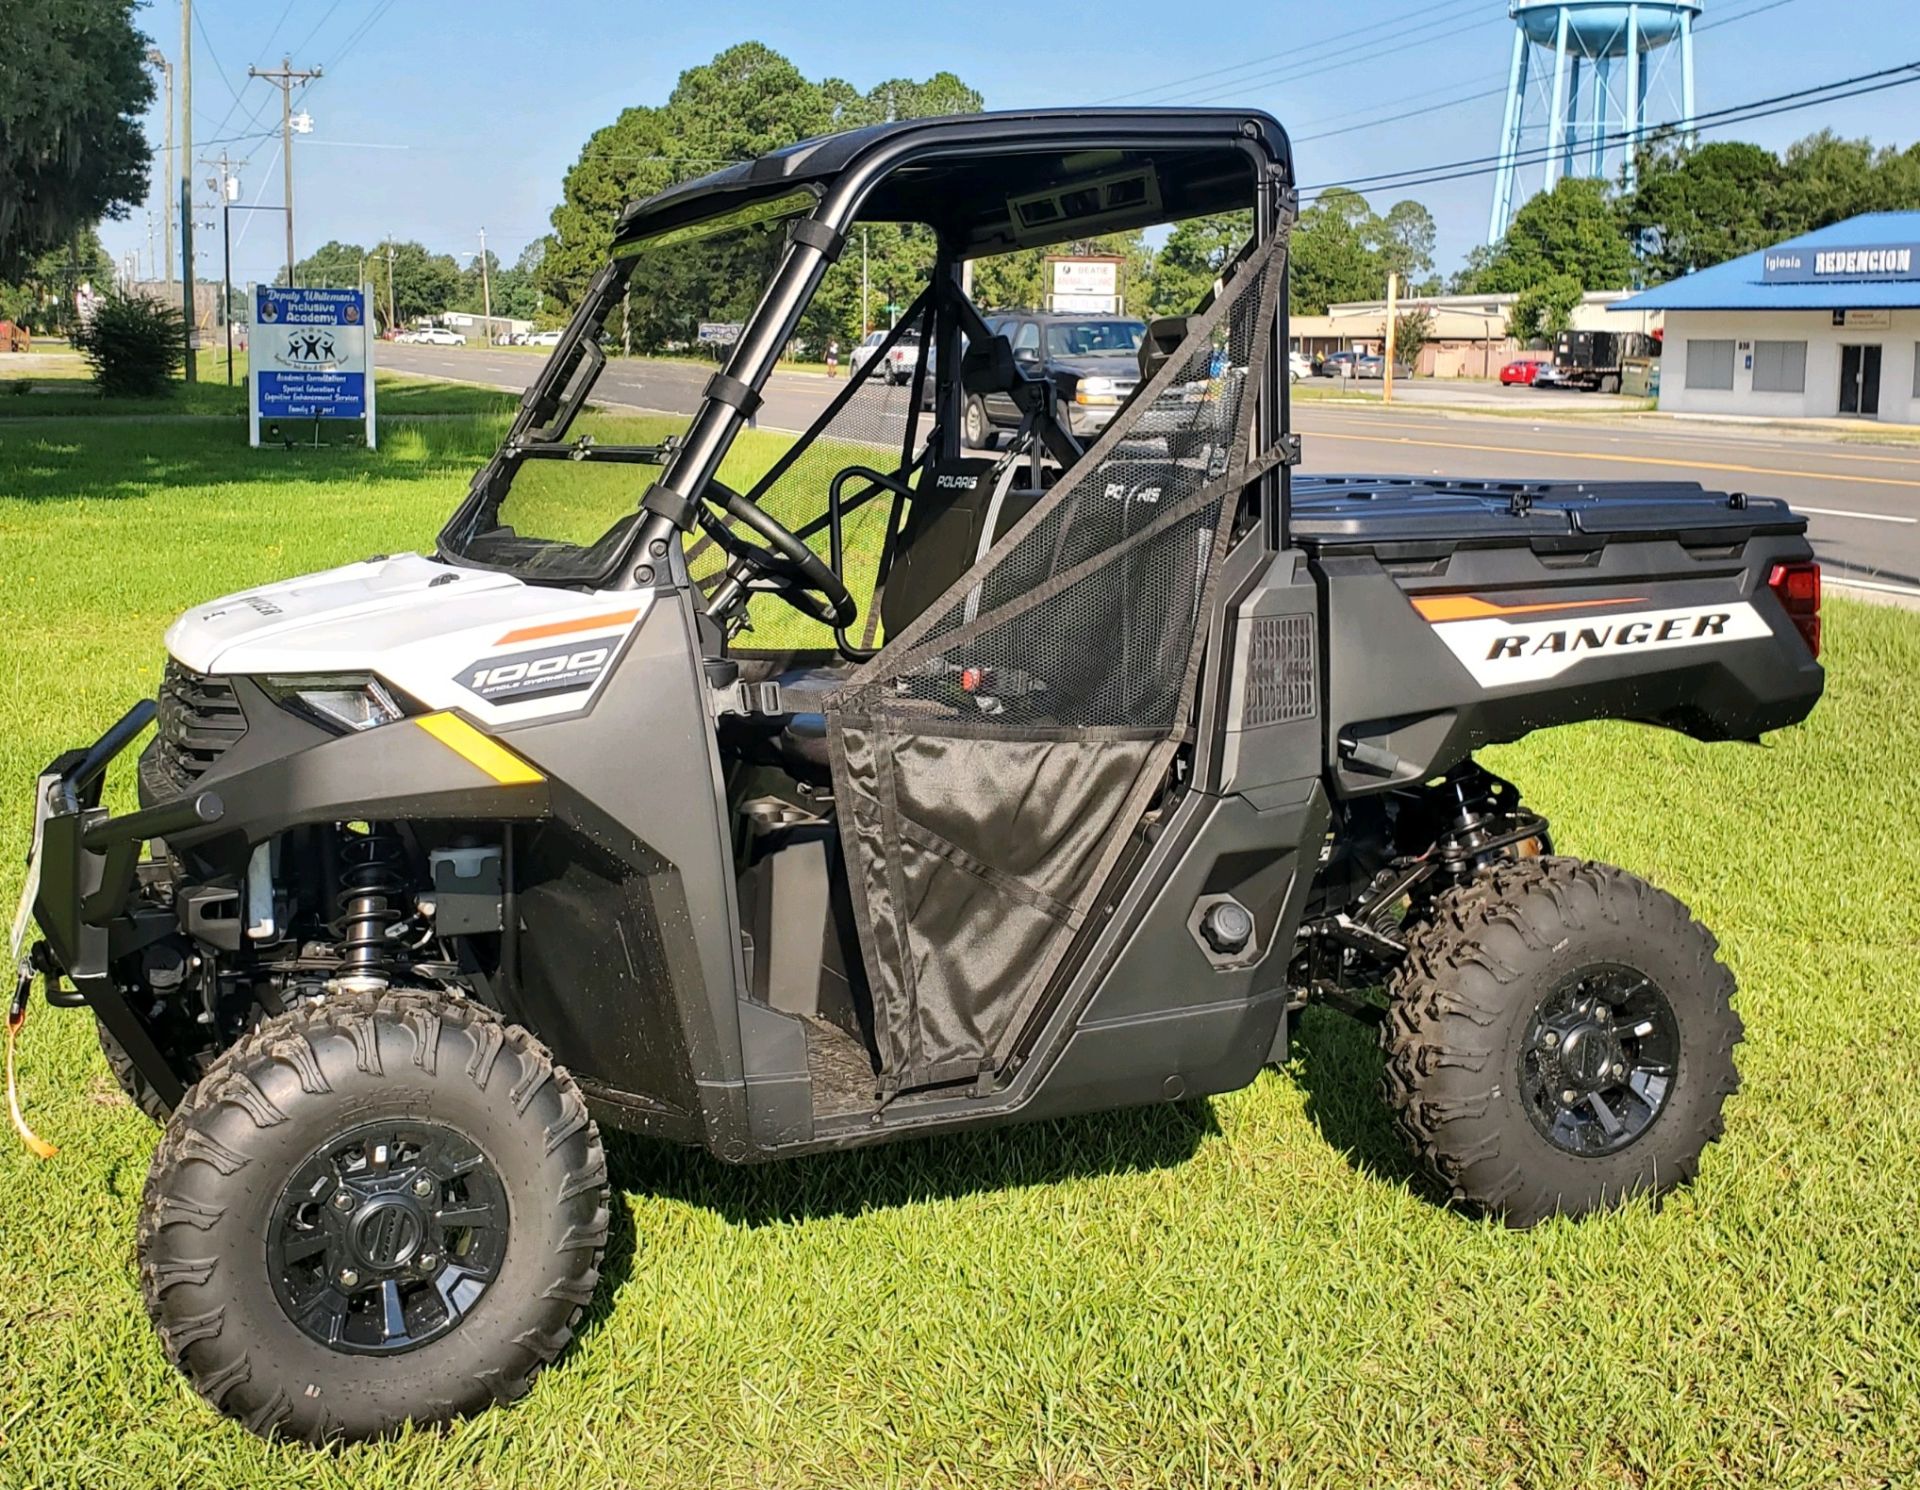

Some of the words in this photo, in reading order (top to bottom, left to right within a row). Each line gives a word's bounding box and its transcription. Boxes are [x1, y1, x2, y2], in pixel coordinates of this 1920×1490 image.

[1766, 256, 1801, 271] Iglesia
[1814, 249, 1911, 275] REDENCION
[267, 290, 300, 303] Deputy
[288, 302, 335, 312] Inclusive
[286, 312, 338, 325] Academy
[276, 373, 304, 382] Academic
[282, 384, 304, 394] Special
[306, 384, 335, 393] Education
[264, 392, 291, 403] Cognitive
[293, 393, 333, 401] Enhancement
[334, 394, 359, 403] Services
[288, 405, 308, 415] Family
[936, 474, 979, 490] POLARIS
[1485, 613, 1731, 661] RANGER
[472, 647, 608, 688] 1000
[482, 681, 520, 694] SINGLE
